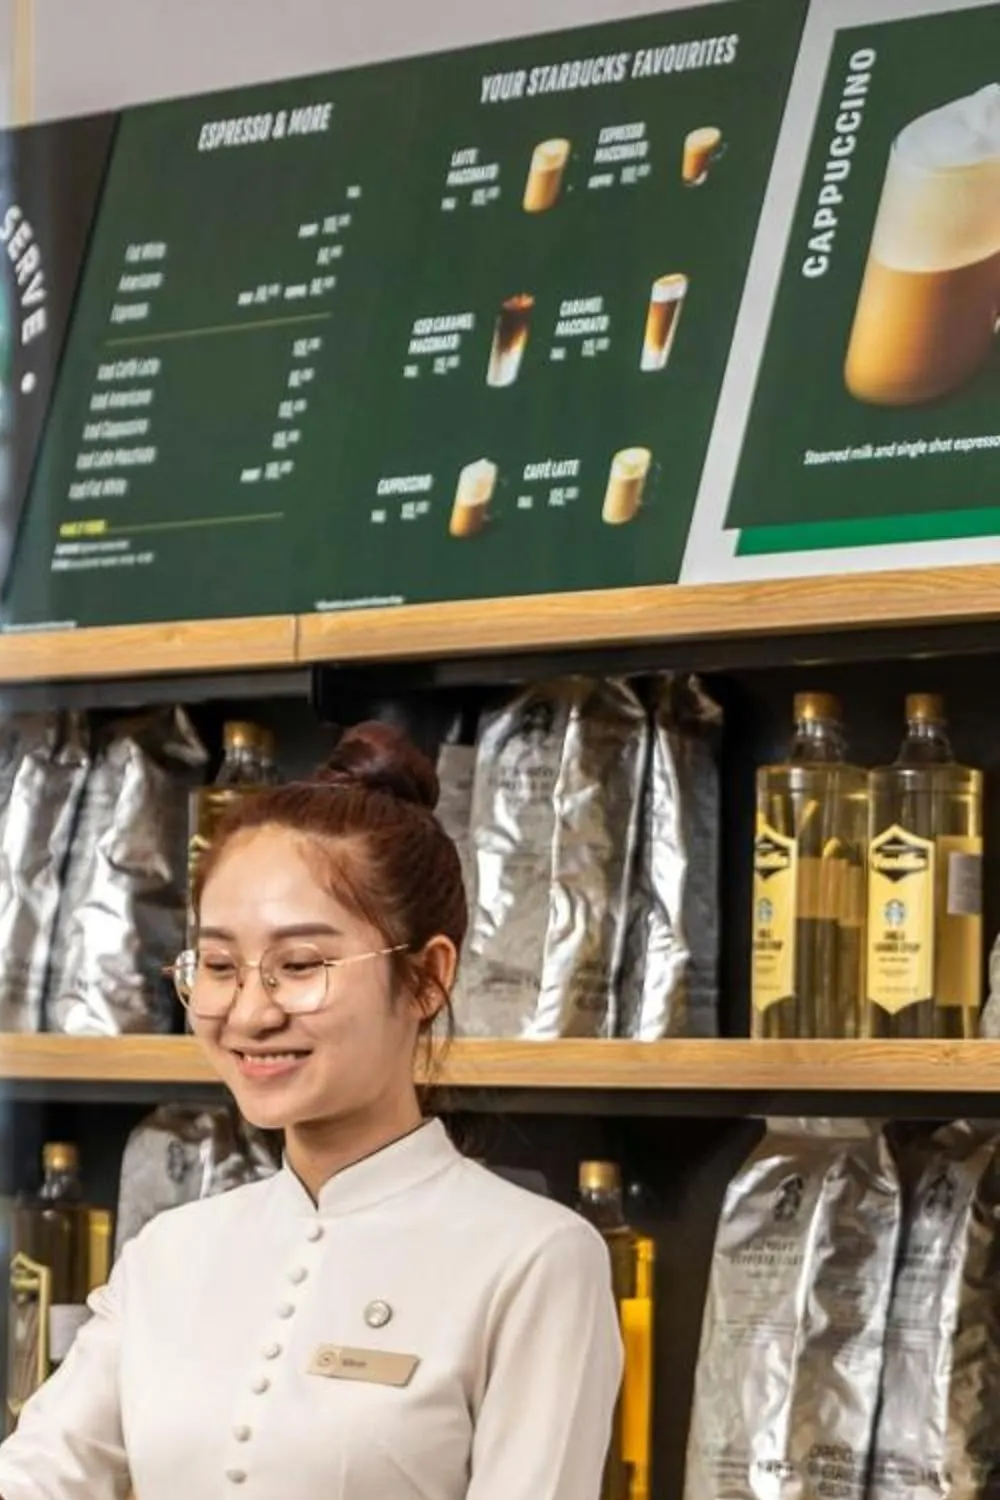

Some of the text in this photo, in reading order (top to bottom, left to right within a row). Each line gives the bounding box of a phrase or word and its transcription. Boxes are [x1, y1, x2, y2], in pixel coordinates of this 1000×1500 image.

[481, 33, 739, 103] YOUR STARBUCKS FAVOURITES
[198, 102, 334, 151] ESPRESSO & MORE
[802, 48, 876, 278] CAPPUCCINO
[551, 458, 581, 479] LATTE
[803, 434, 1000, 465] Steamed milk and single shot espresso
